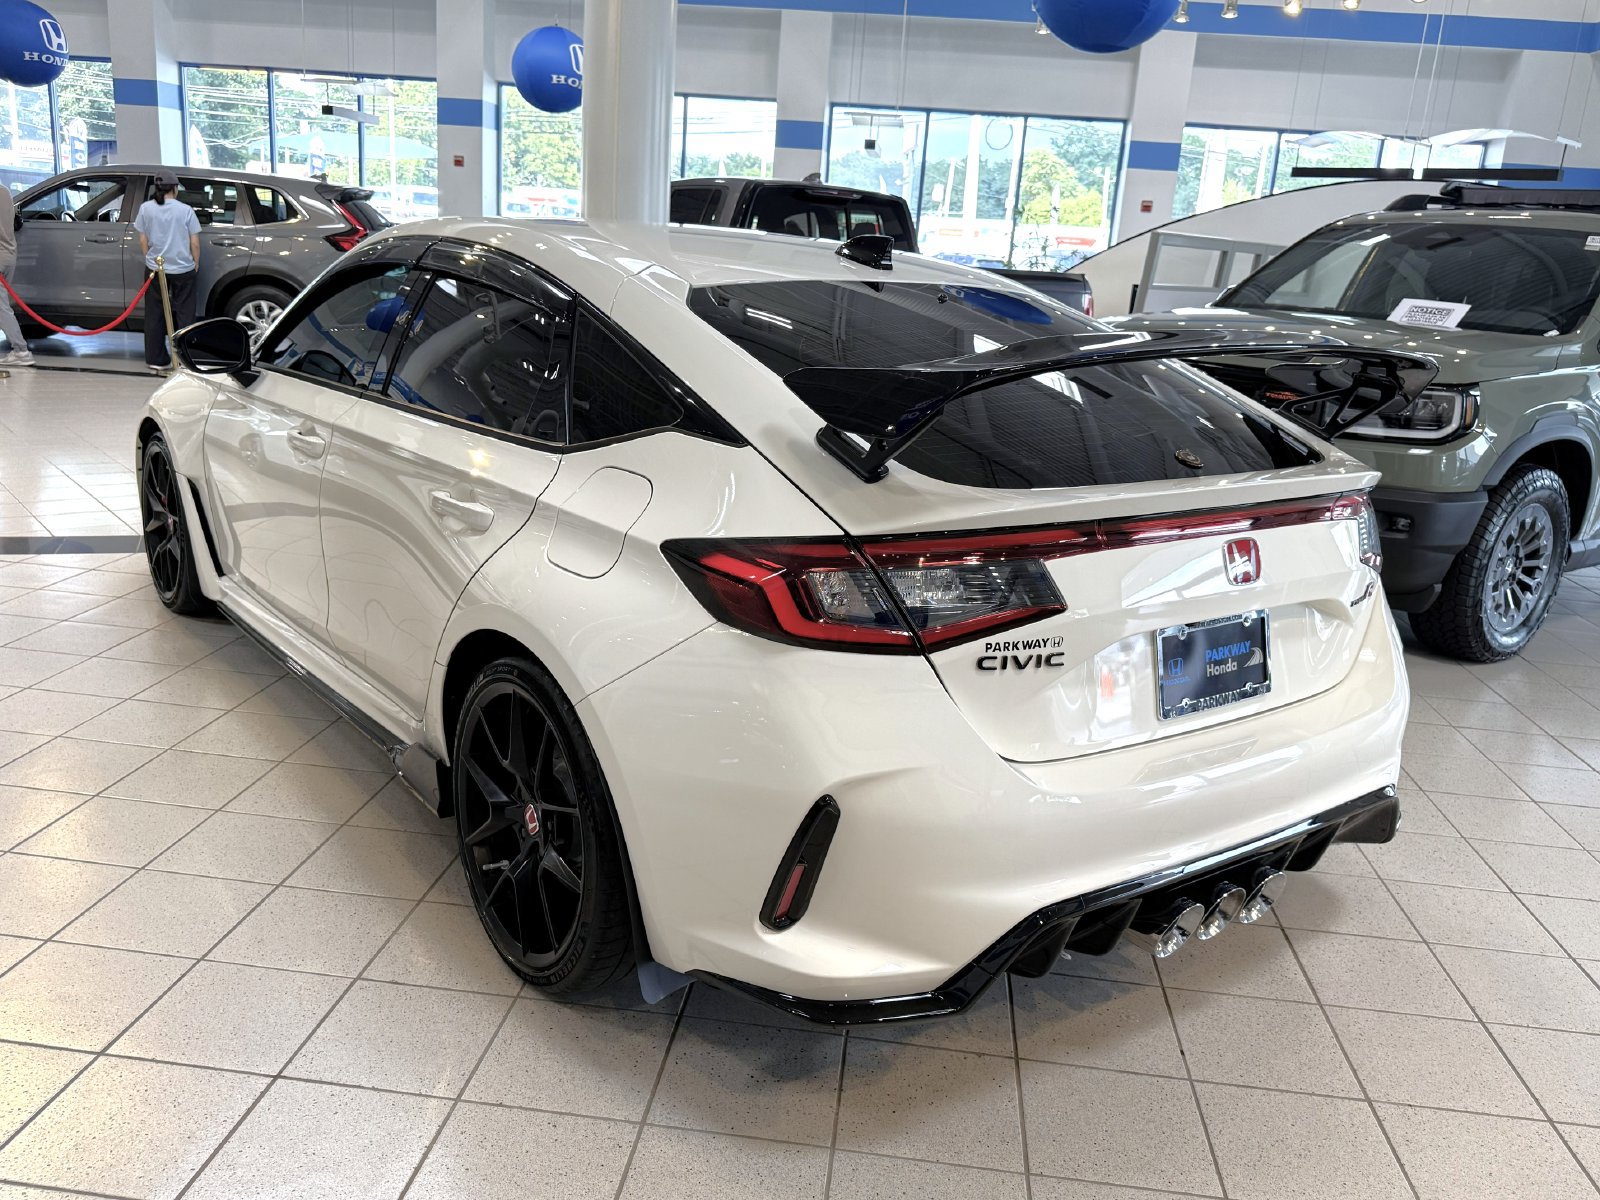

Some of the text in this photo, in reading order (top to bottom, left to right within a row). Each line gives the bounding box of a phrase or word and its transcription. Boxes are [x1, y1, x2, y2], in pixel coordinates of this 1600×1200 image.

[551, 74, 583, 90] HO
[1410, 306, 1452, 316] NOTICE
[985, 637, 1050, 653] PARKWAY
[1205, 640, 1251, 663] PARKWAY
[976, 651, 1065, 671] CIVIC
[1206, 658, 1238, 678] Honda
[1197, 689, 1242, 712] PARKWAY
